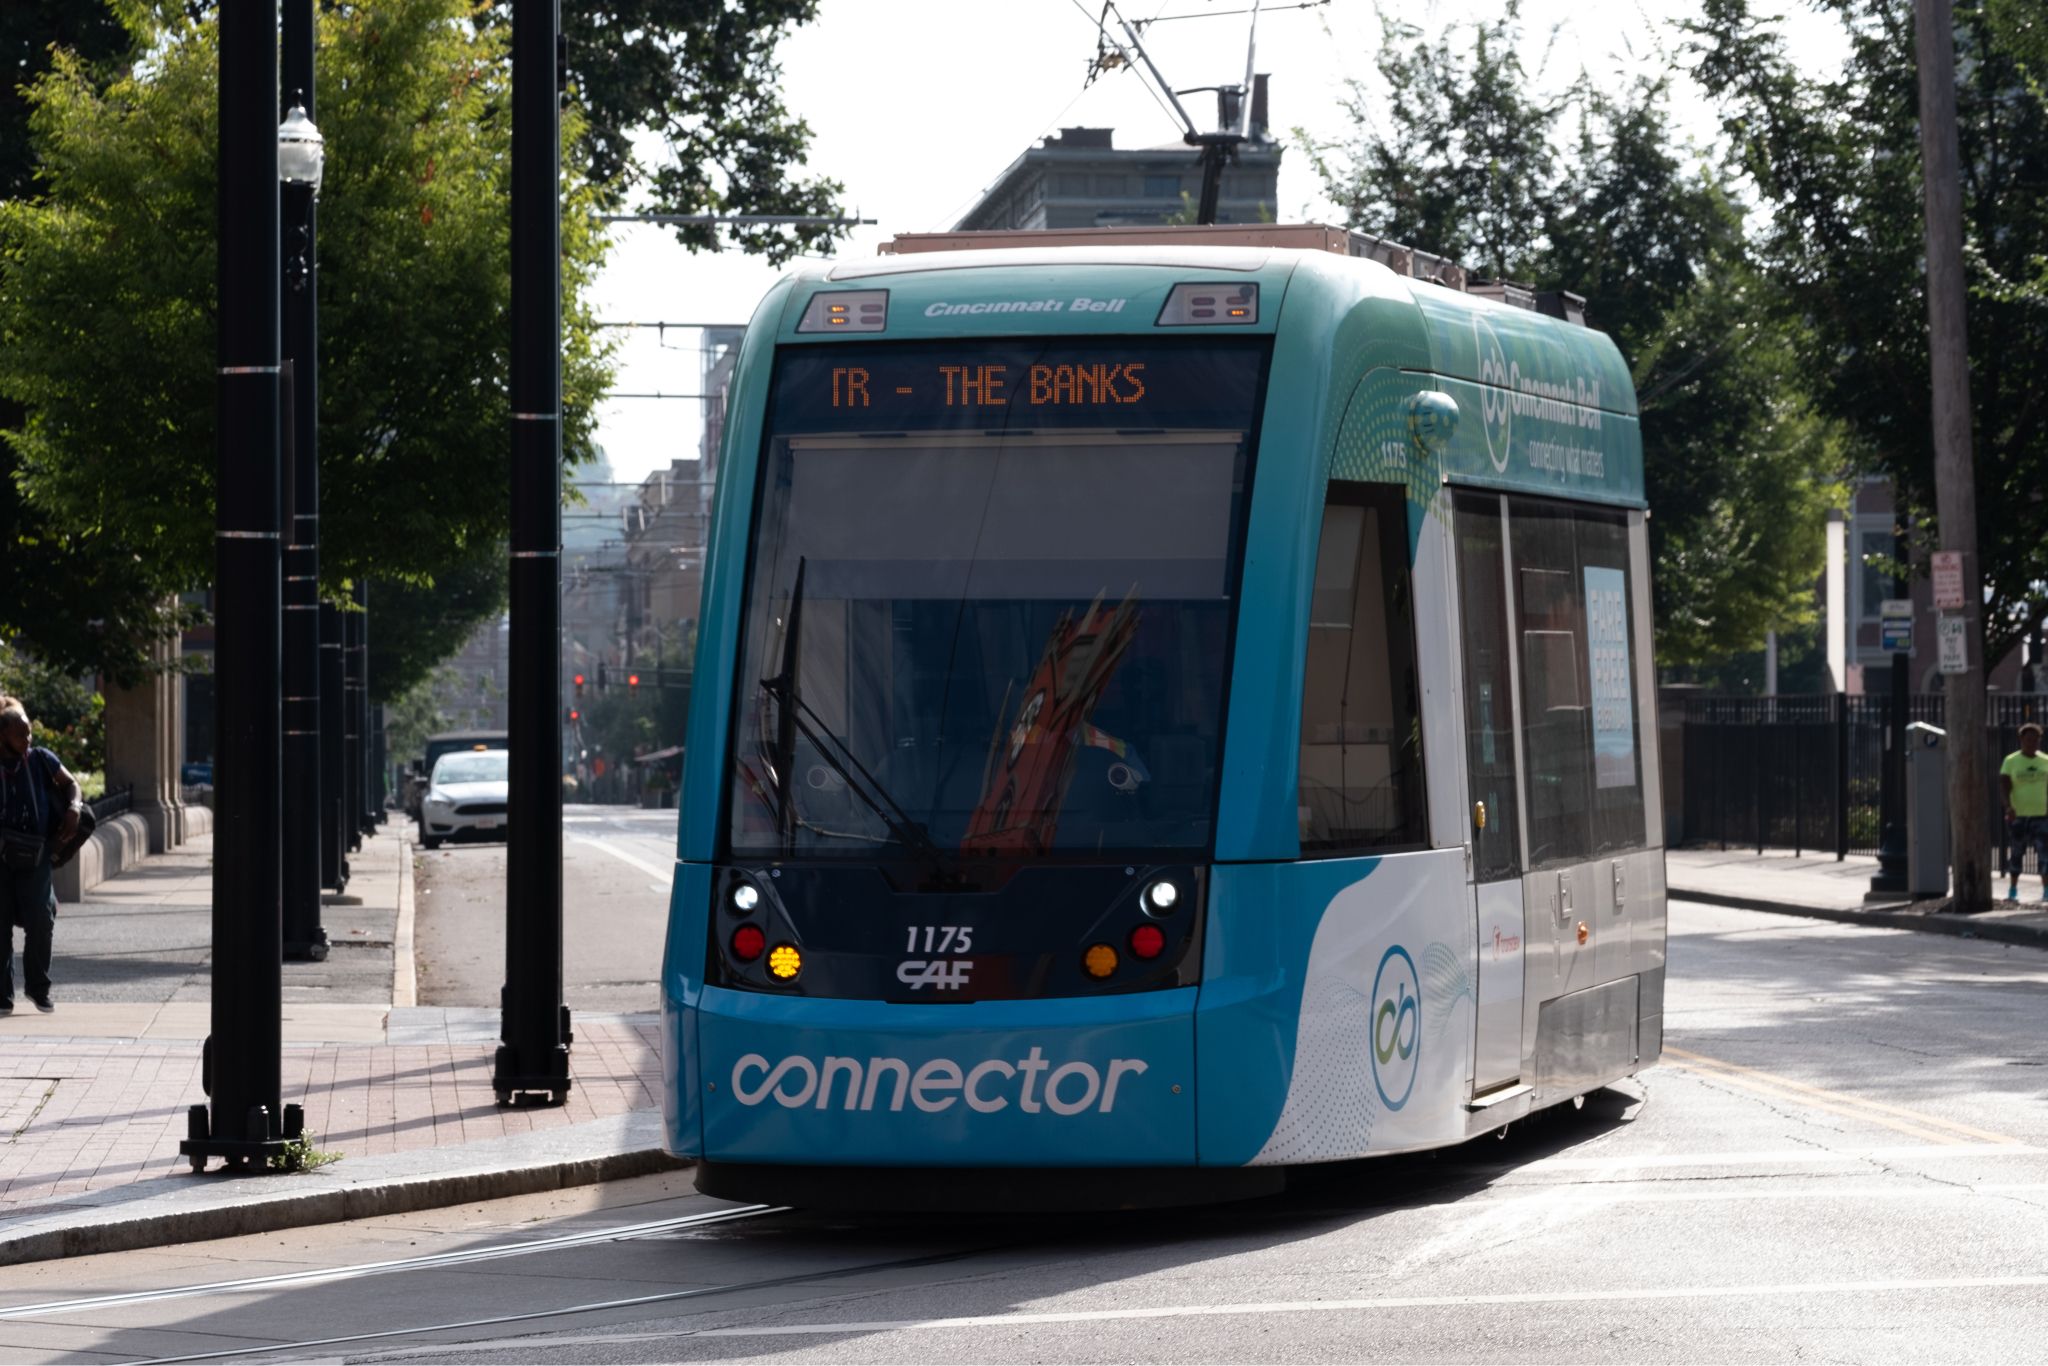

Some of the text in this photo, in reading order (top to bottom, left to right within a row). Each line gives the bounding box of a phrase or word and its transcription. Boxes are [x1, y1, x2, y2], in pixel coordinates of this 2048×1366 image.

[924, 298, 1126, 318] Cincinnati Bell
[939, 366, 1007, 405] THE
[1030, 363, 1145, 405] BANKS
[1510, 361, 1601, 430] Cincinnati Bell
[1381, 441, 1407, 469] 1175
[1591, 589, 1623, 643] FARE
[1595, 647, 1627, 700] FREE
[906, 926, 973, 954] 1175
[897, 960, 973, 990] CAF
[731, 1046, 1148, 1116] connector
